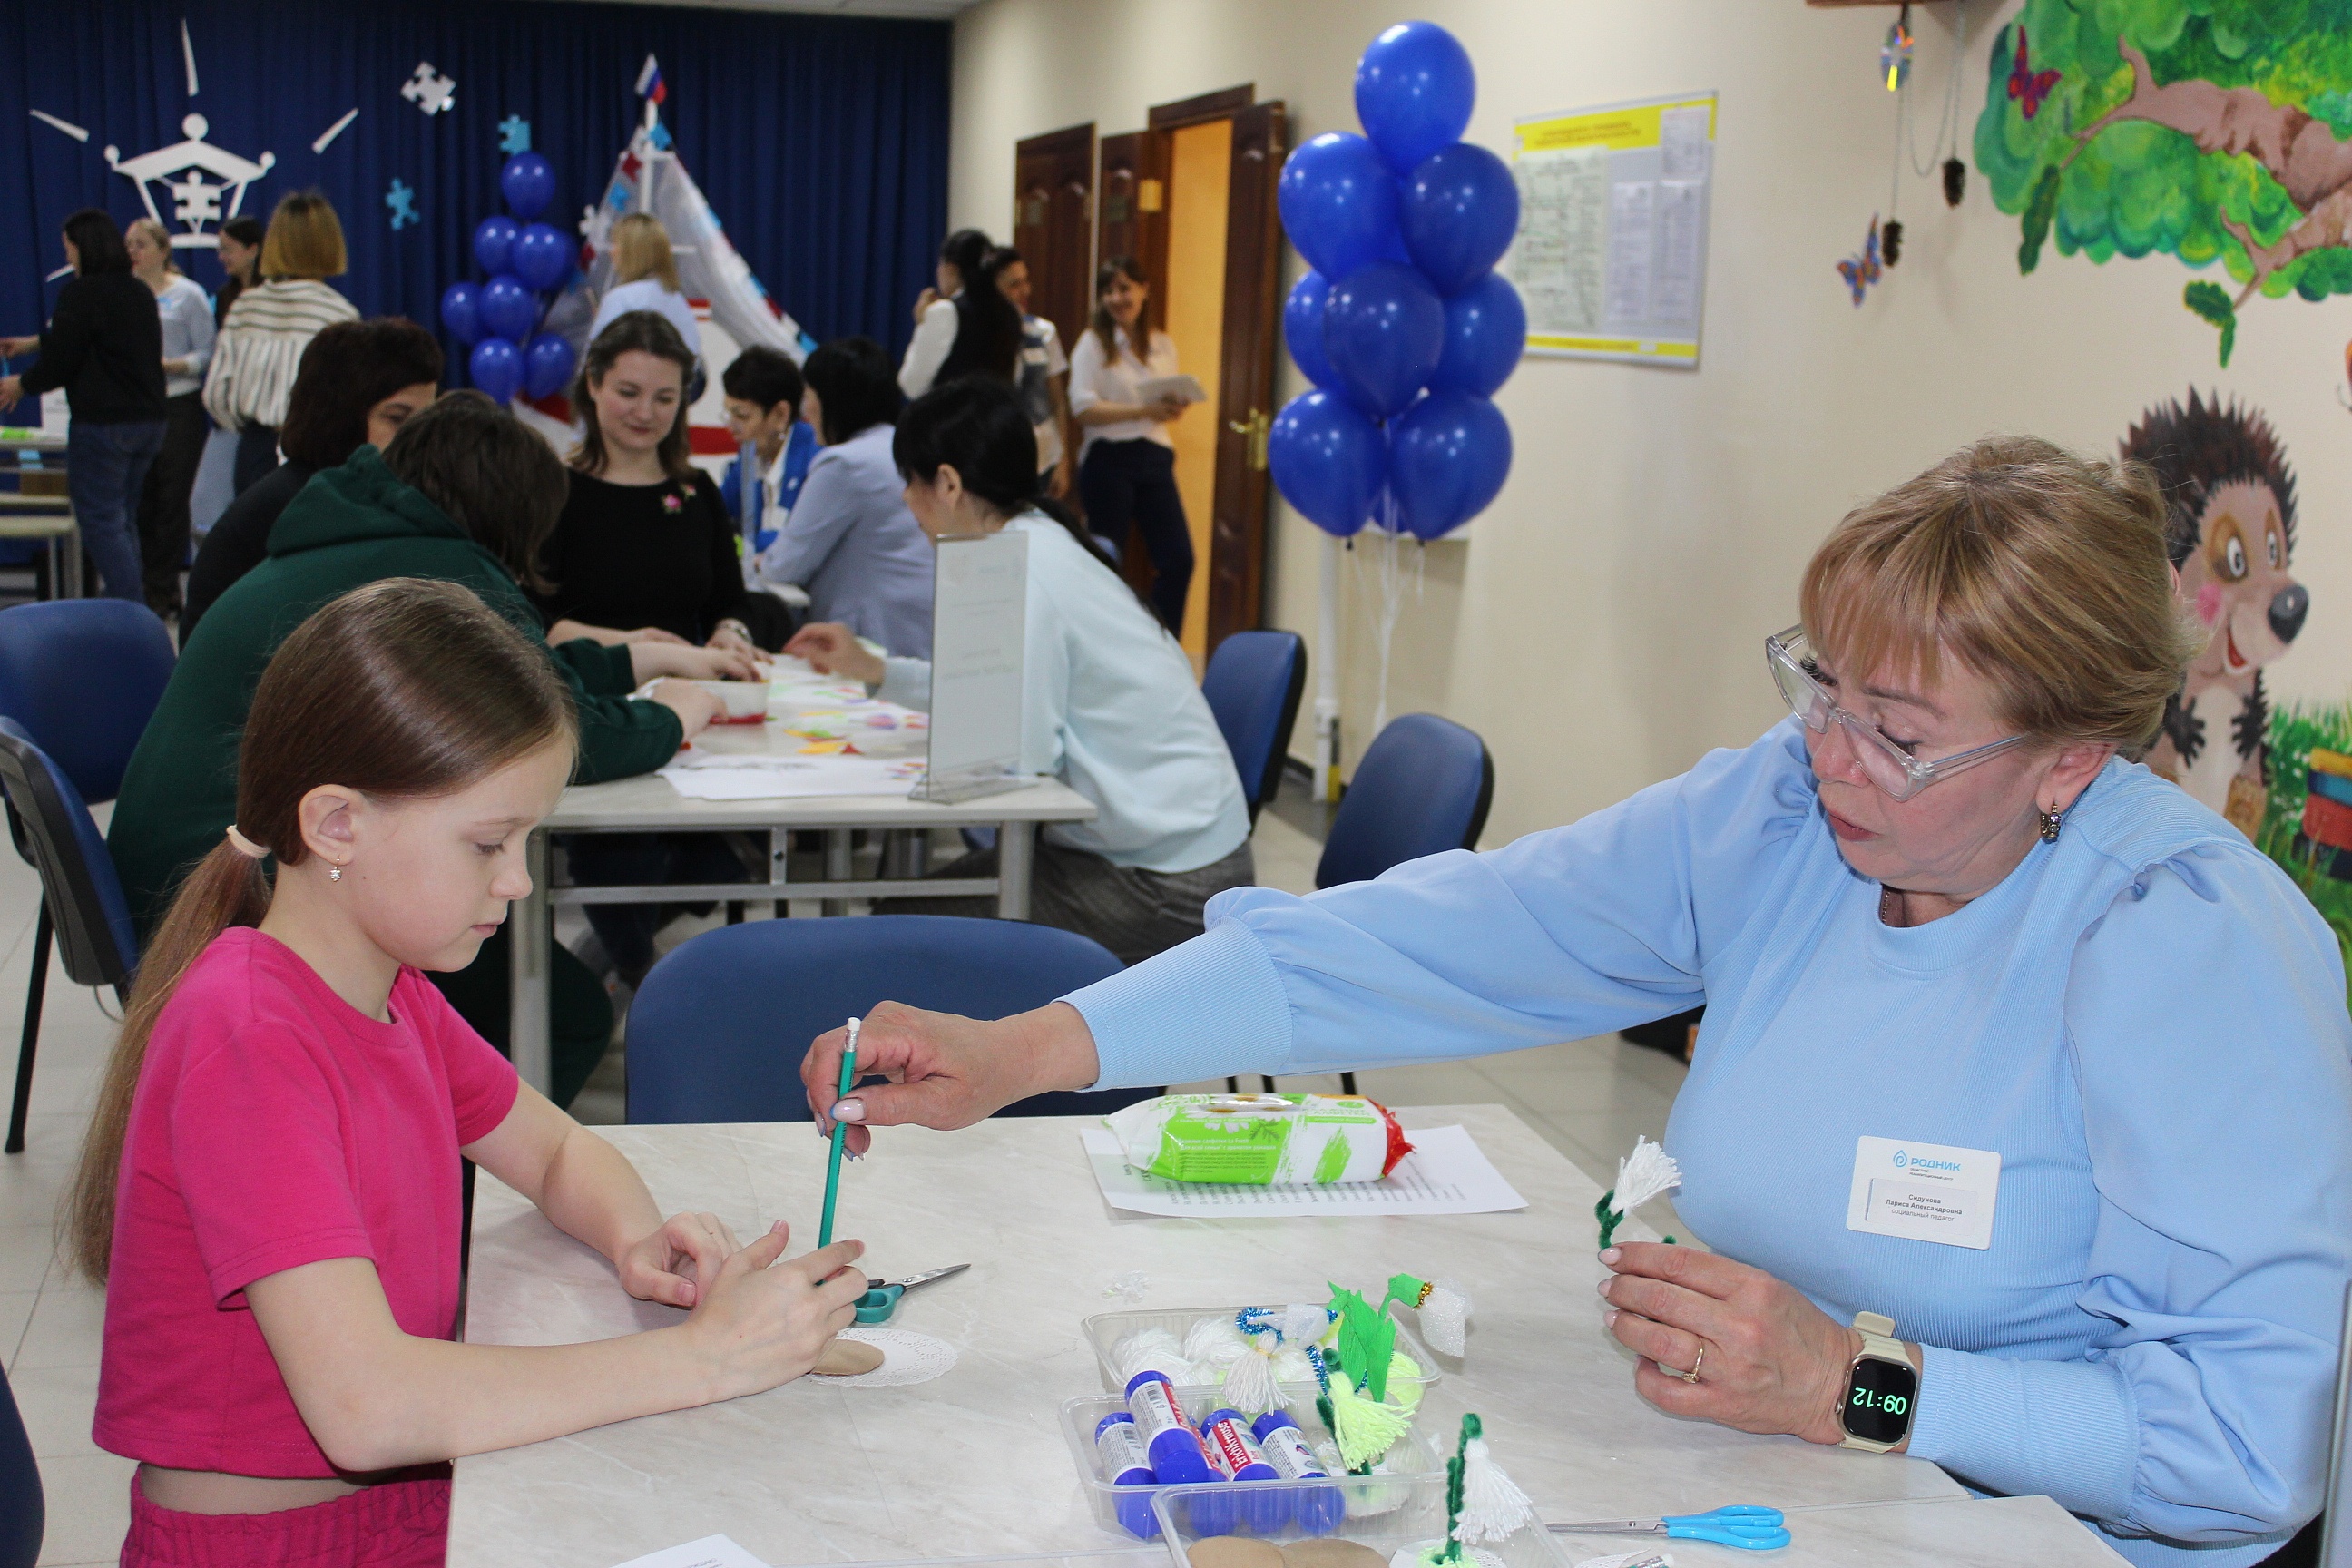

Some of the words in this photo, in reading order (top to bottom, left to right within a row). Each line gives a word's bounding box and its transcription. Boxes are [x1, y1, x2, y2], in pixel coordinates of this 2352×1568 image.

[1911, 1157, 1962, 1171] РОДНИК
[1908, 1194, 1941, 1204] Сидунова
[1886, 1199, 1909, 1208] Лариса
[1910, 1202, 1963, 1215] Александровна
[1891, 1209, 1929, 1219] социальный
[1930, 1213, 1955, 1222] педагог
[1852, 1387, 1907, 1416] 09:12
[1217, 1421, 1249, 1468] ErichKrause
